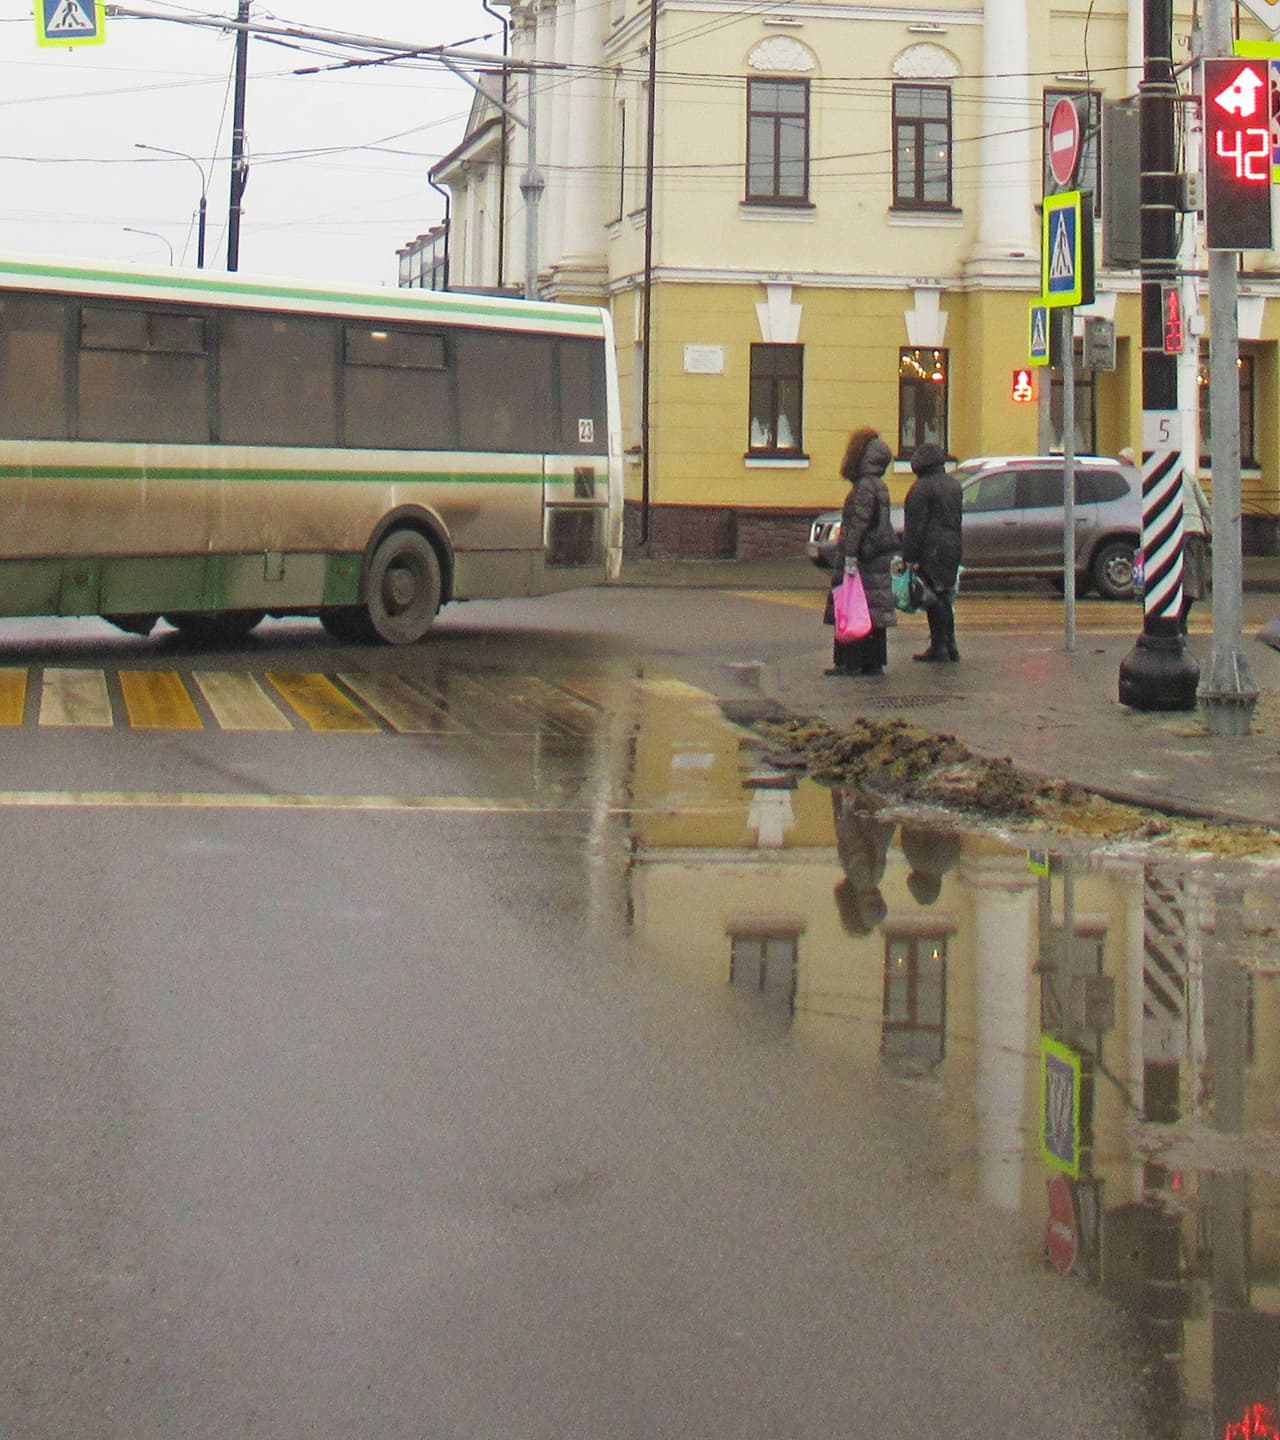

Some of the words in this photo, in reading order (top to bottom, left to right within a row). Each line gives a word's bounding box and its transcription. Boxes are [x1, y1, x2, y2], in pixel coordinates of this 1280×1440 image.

[1216, 128, 1269, 179] 42
[580, 421, 593, 440] 23
[1159, 419, 1171, 443] 5
